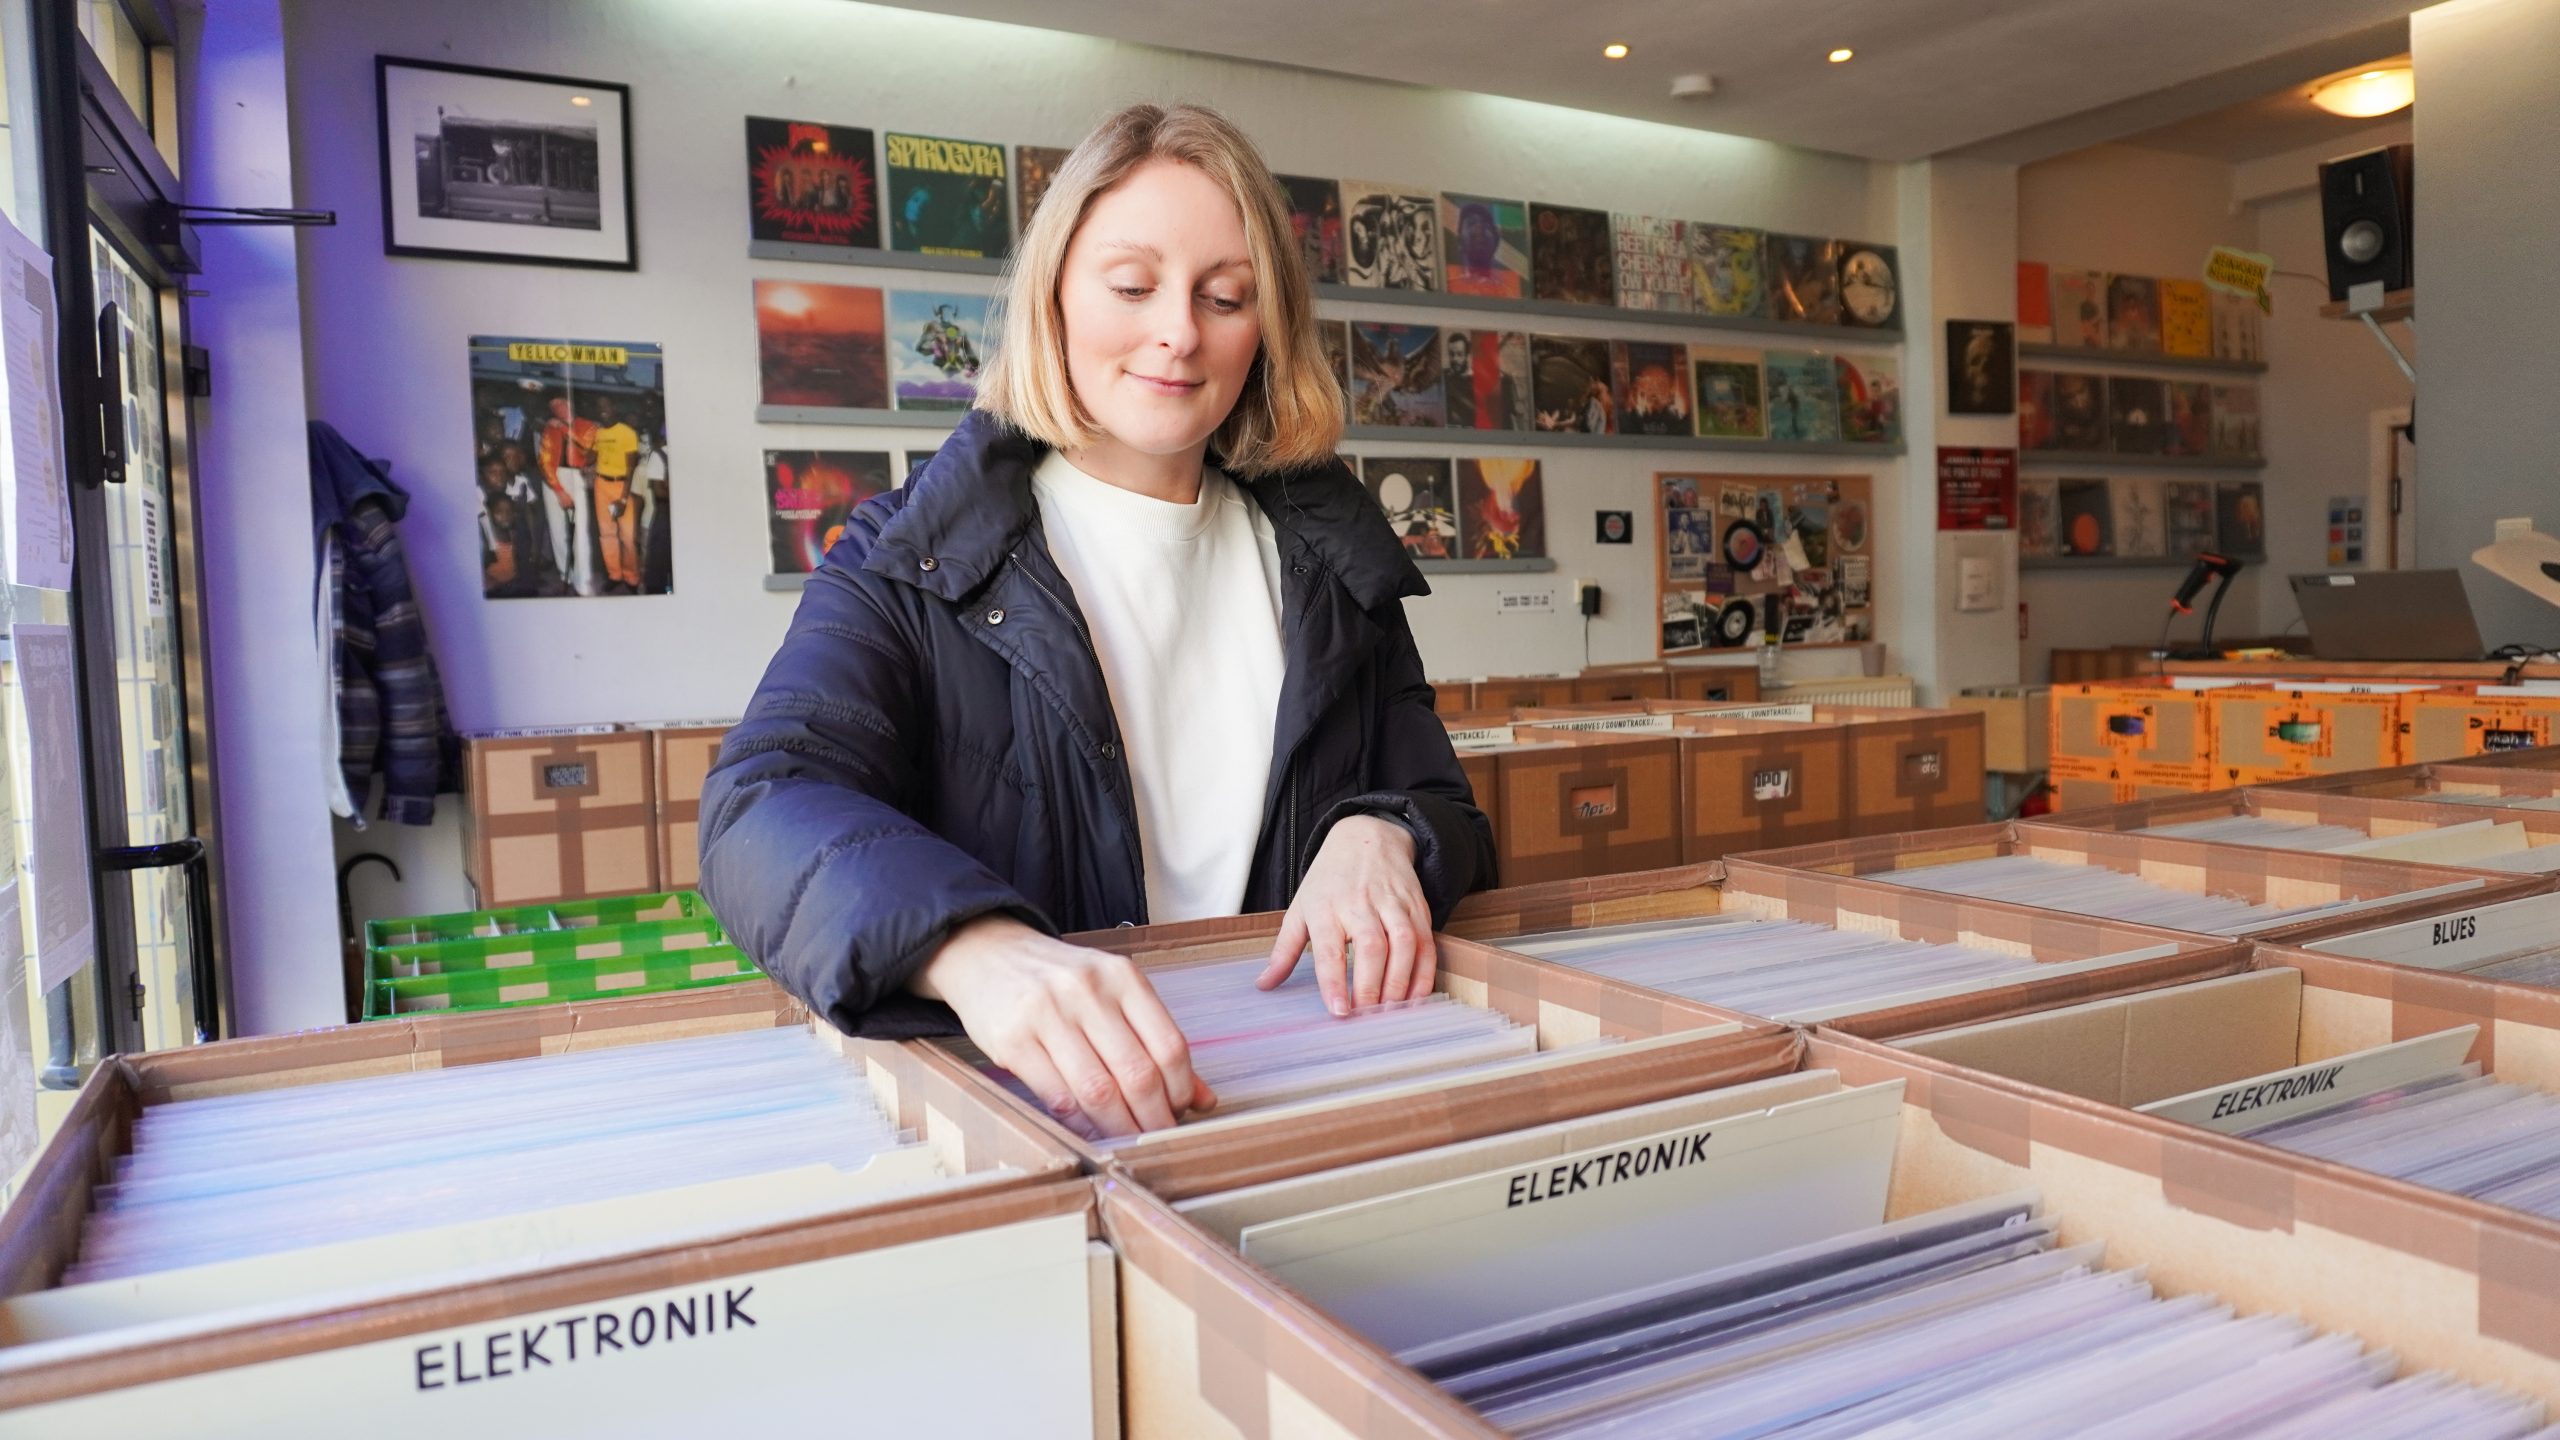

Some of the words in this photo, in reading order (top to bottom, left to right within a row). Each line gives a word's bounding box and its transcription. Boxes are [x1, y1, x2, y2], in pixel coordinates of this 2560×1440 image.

[886, 134, 1005, 177] SPIROGYRA
[515, 344, 618, 363] YELLOWMAN
[1605, 718, 1651, 729] SOUNDTRACKS
[2433, 915, 2477, 946] BLUES
[2211, 1064, 2344, 1120] ELEKTRONIK
[1507, 1132, 1713, 1208] ELEKTRONIK
[416, 1286, 759, 1391] ELEKTRONIK
